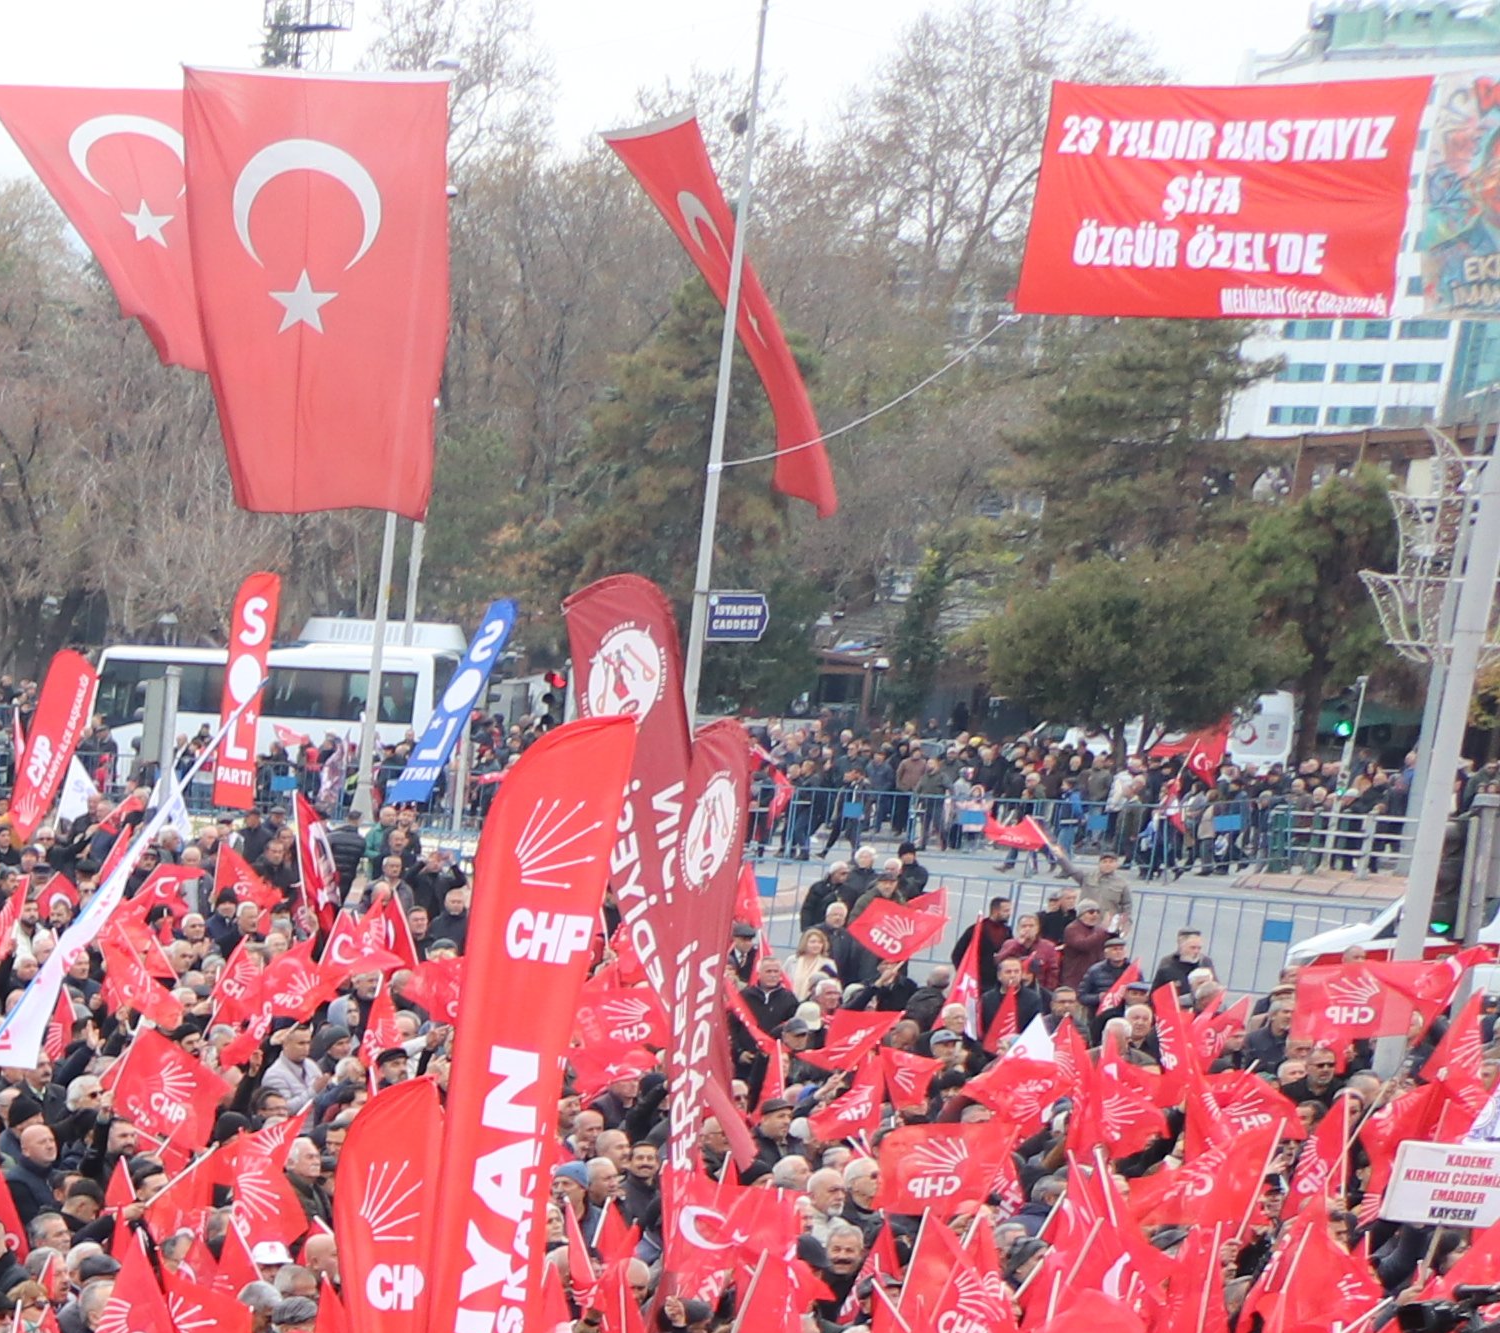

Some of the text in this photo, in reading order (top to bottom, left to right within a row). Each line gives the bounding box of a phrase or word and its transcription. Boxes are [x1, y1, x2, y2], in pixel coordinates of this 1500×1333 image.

[1058, 115, 1395, 162] 23 YILDIR HASTAYIZ
[1162, 170, 1242, 220] ŞİFA
[1074, 220, 1327, 275] ÖZGÜR ÖZEL'DE
[28, 735, 51, 787] CHP
[507, 909, 589, 962] CHP
[223, 979, 245, 997] CH
[149, 1093, 186, 1123] CHP
[1404, 1168, 1451, 1184] KIRMIZI
[1446, 1154, 1494, 1170] KADEME
[1429, 1205, 1477, 1222] KAYSERİ
